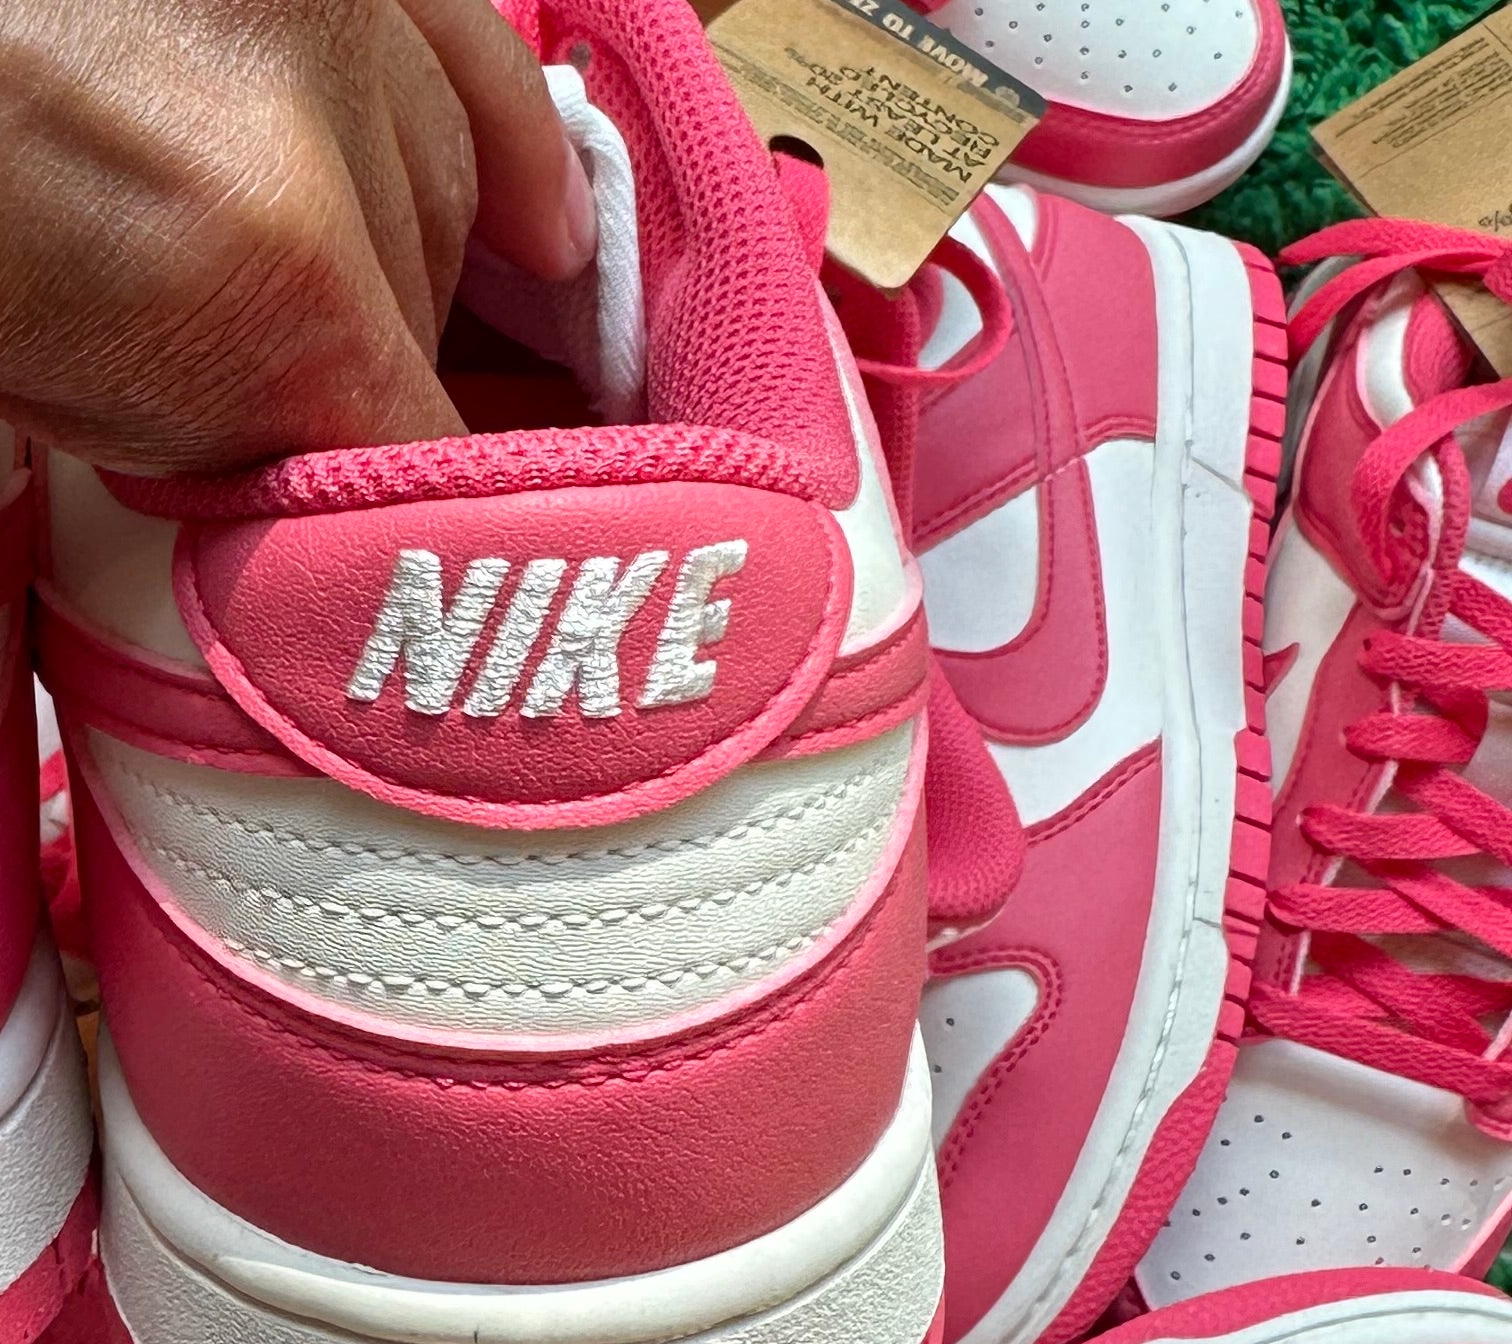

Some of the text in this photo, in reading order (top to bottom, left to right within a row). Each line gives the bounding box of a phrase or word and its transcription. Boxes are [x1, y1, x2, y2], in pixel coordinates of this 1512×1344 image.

[882, 12, 916, 40] TO
[916, 34, 989, 87] MOVE
[806, 76, 973, 184] MADE WITH
[837, 66, 992, 160] RECYCLED
[847, 88, 941, 144] LEAST
[864, 66, 1000, 149] CONTENT
[942, 145, 987, 169] AT
[345, 538, 748, 718] NIKE
